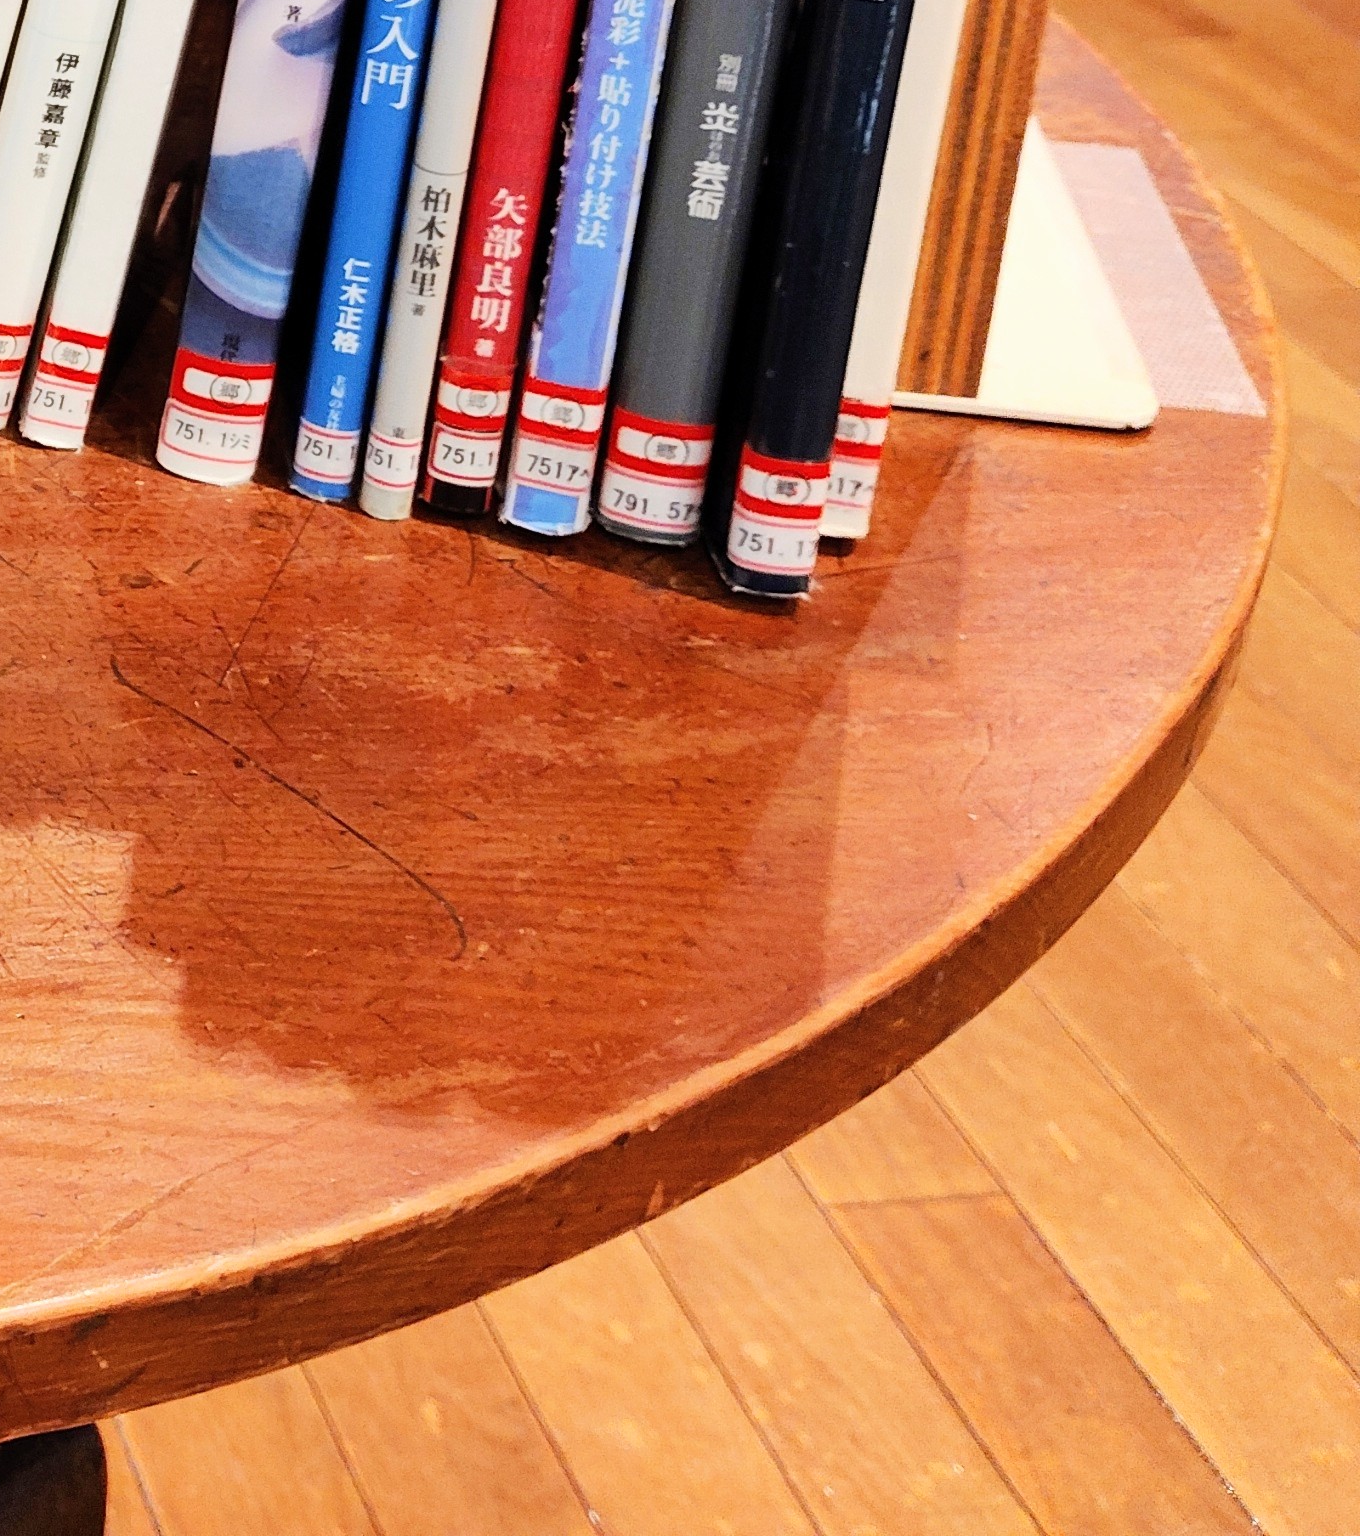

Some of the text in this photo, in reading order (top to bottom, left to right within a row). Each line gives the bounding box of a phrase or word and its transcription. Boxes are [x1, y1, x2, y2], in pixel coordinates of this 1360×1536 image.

[36, 53, 80, 149] 伊藤嘉章
[407, 184, 451, 300] 柏木麻里
[470, 188, 529, 334] 矢部良明
[331, 257, 373, 355] 仁木正格
